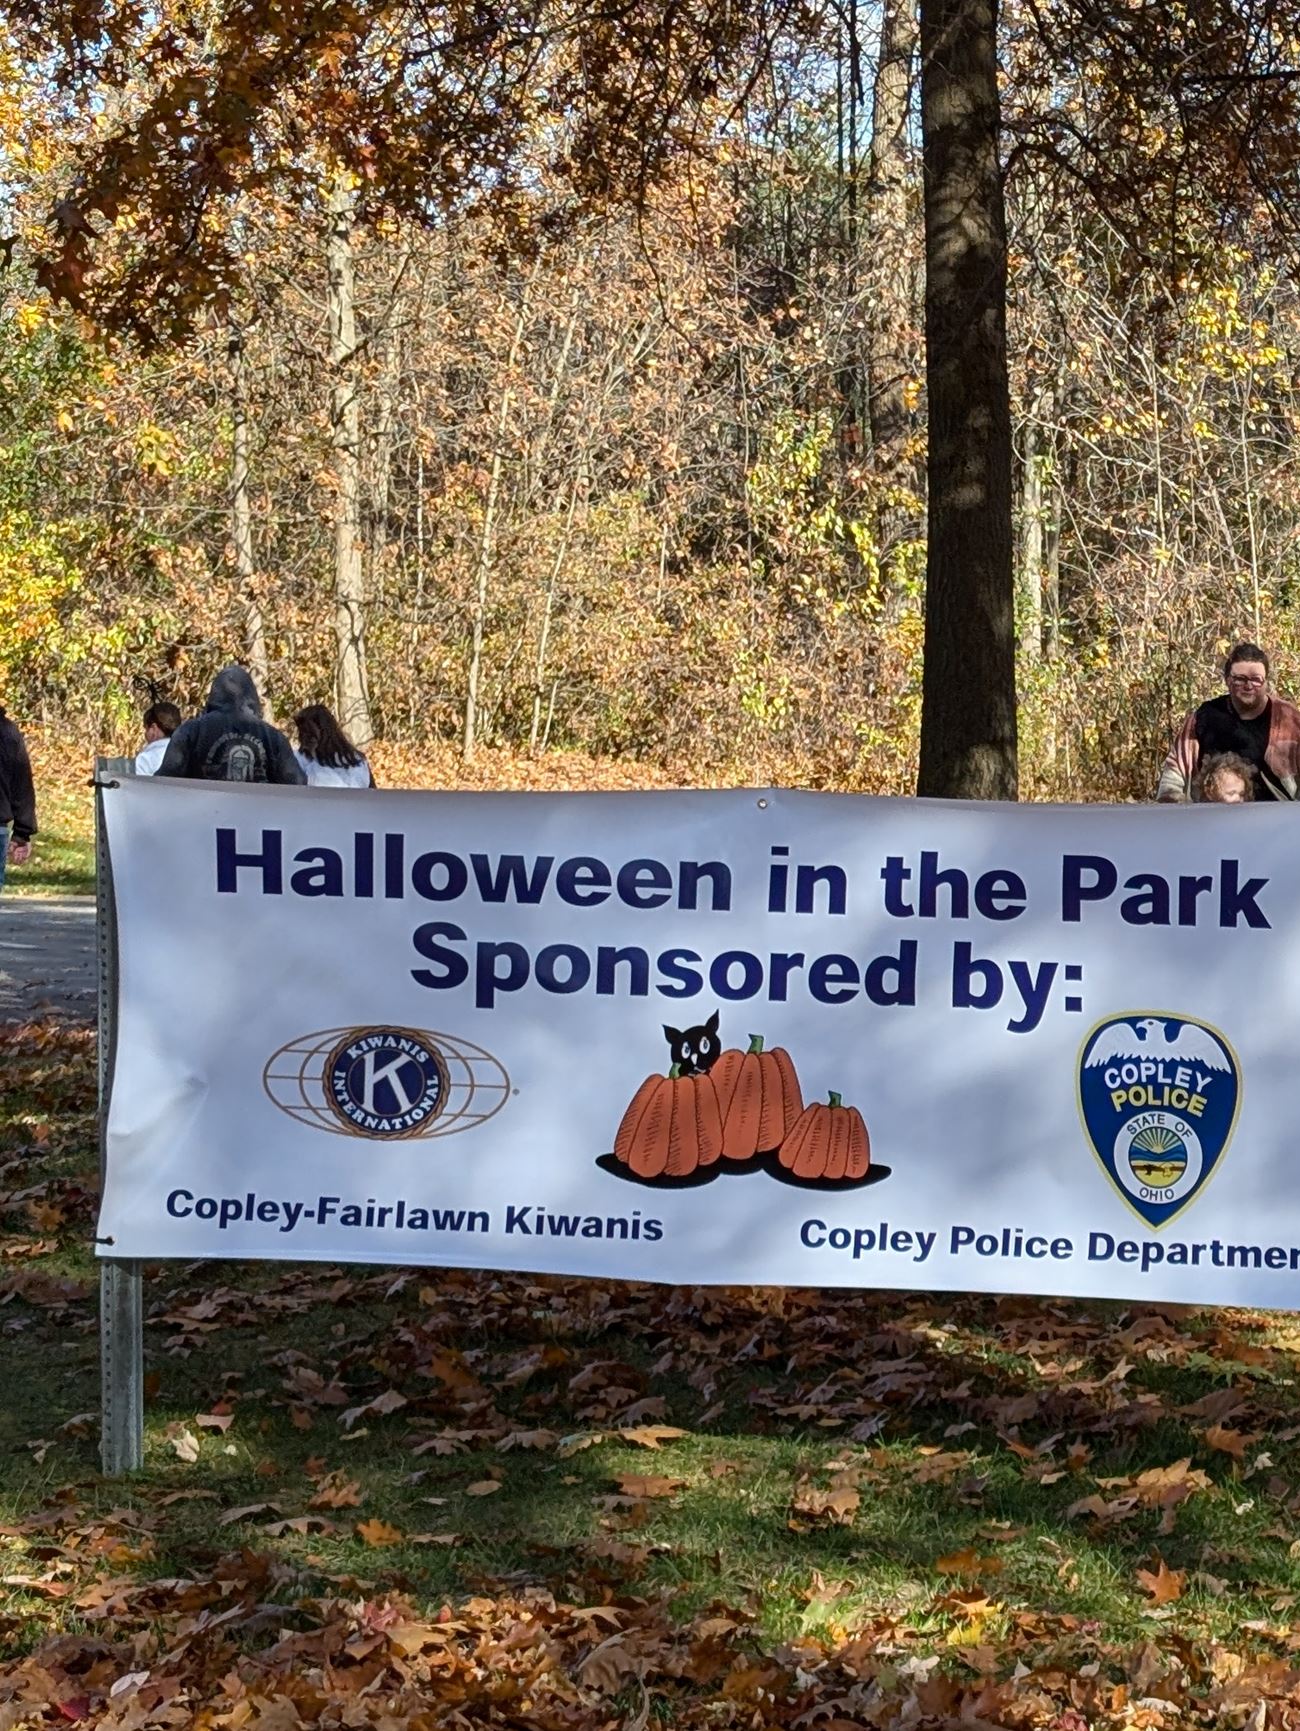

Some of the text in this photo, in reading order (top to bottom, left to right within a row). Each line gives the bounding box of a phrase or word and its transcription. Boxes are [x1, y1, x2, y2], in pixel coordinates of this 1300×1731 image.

[216, 828, 1271, 929] Halloween in the Park
[411, 922, 1082, 1032] Sponsored by:
[347, 1035, 430, 1064] KIWANIS
[334, 1069, 439, 1131] INTERNATIONAL
[359, 1050, 414, 1115] K
[1104, 1063, 1213, 1093] COPLEY
[1111, 1085, 1208, 1117] POLICE
[1127, 1113, 1193, 1139] STATE OF
[166, 1189, 663, 1241] Copley-Fairlawn Kiwanis
[1139, 1187, 1175, 1201] OHIO
[800, 1219, 937, 1264] Copley
[950, 1226, 1073, 1259] Police
